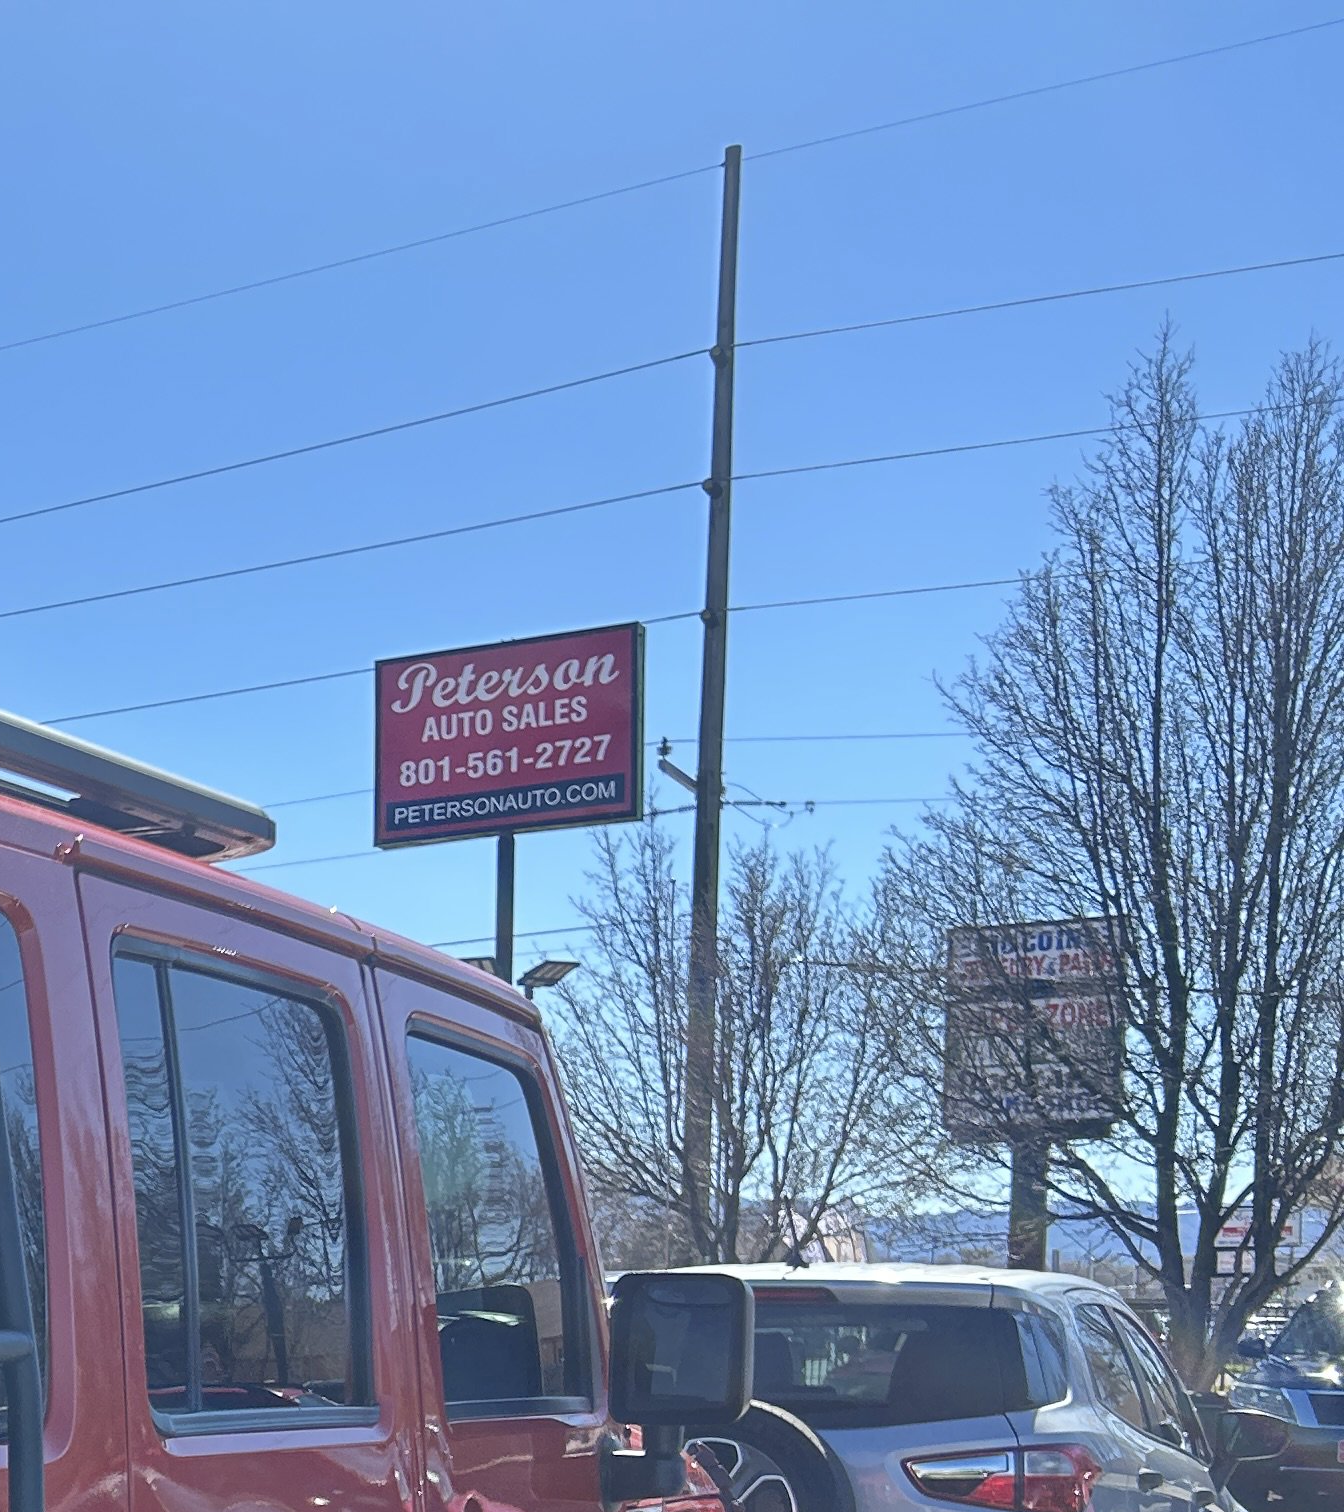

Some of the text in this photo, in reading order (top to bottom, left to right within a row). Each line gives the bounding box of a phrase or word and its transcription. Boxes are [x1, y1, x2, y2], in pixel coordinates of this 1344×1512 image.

[391, 653, 620, 714] Peterson
[421, 695, 588, 743] AUTO SALES
[399, 734, 612, 788] 801-561-2727
[394, 780, 616, 825] PETERSONAUTO.COM
